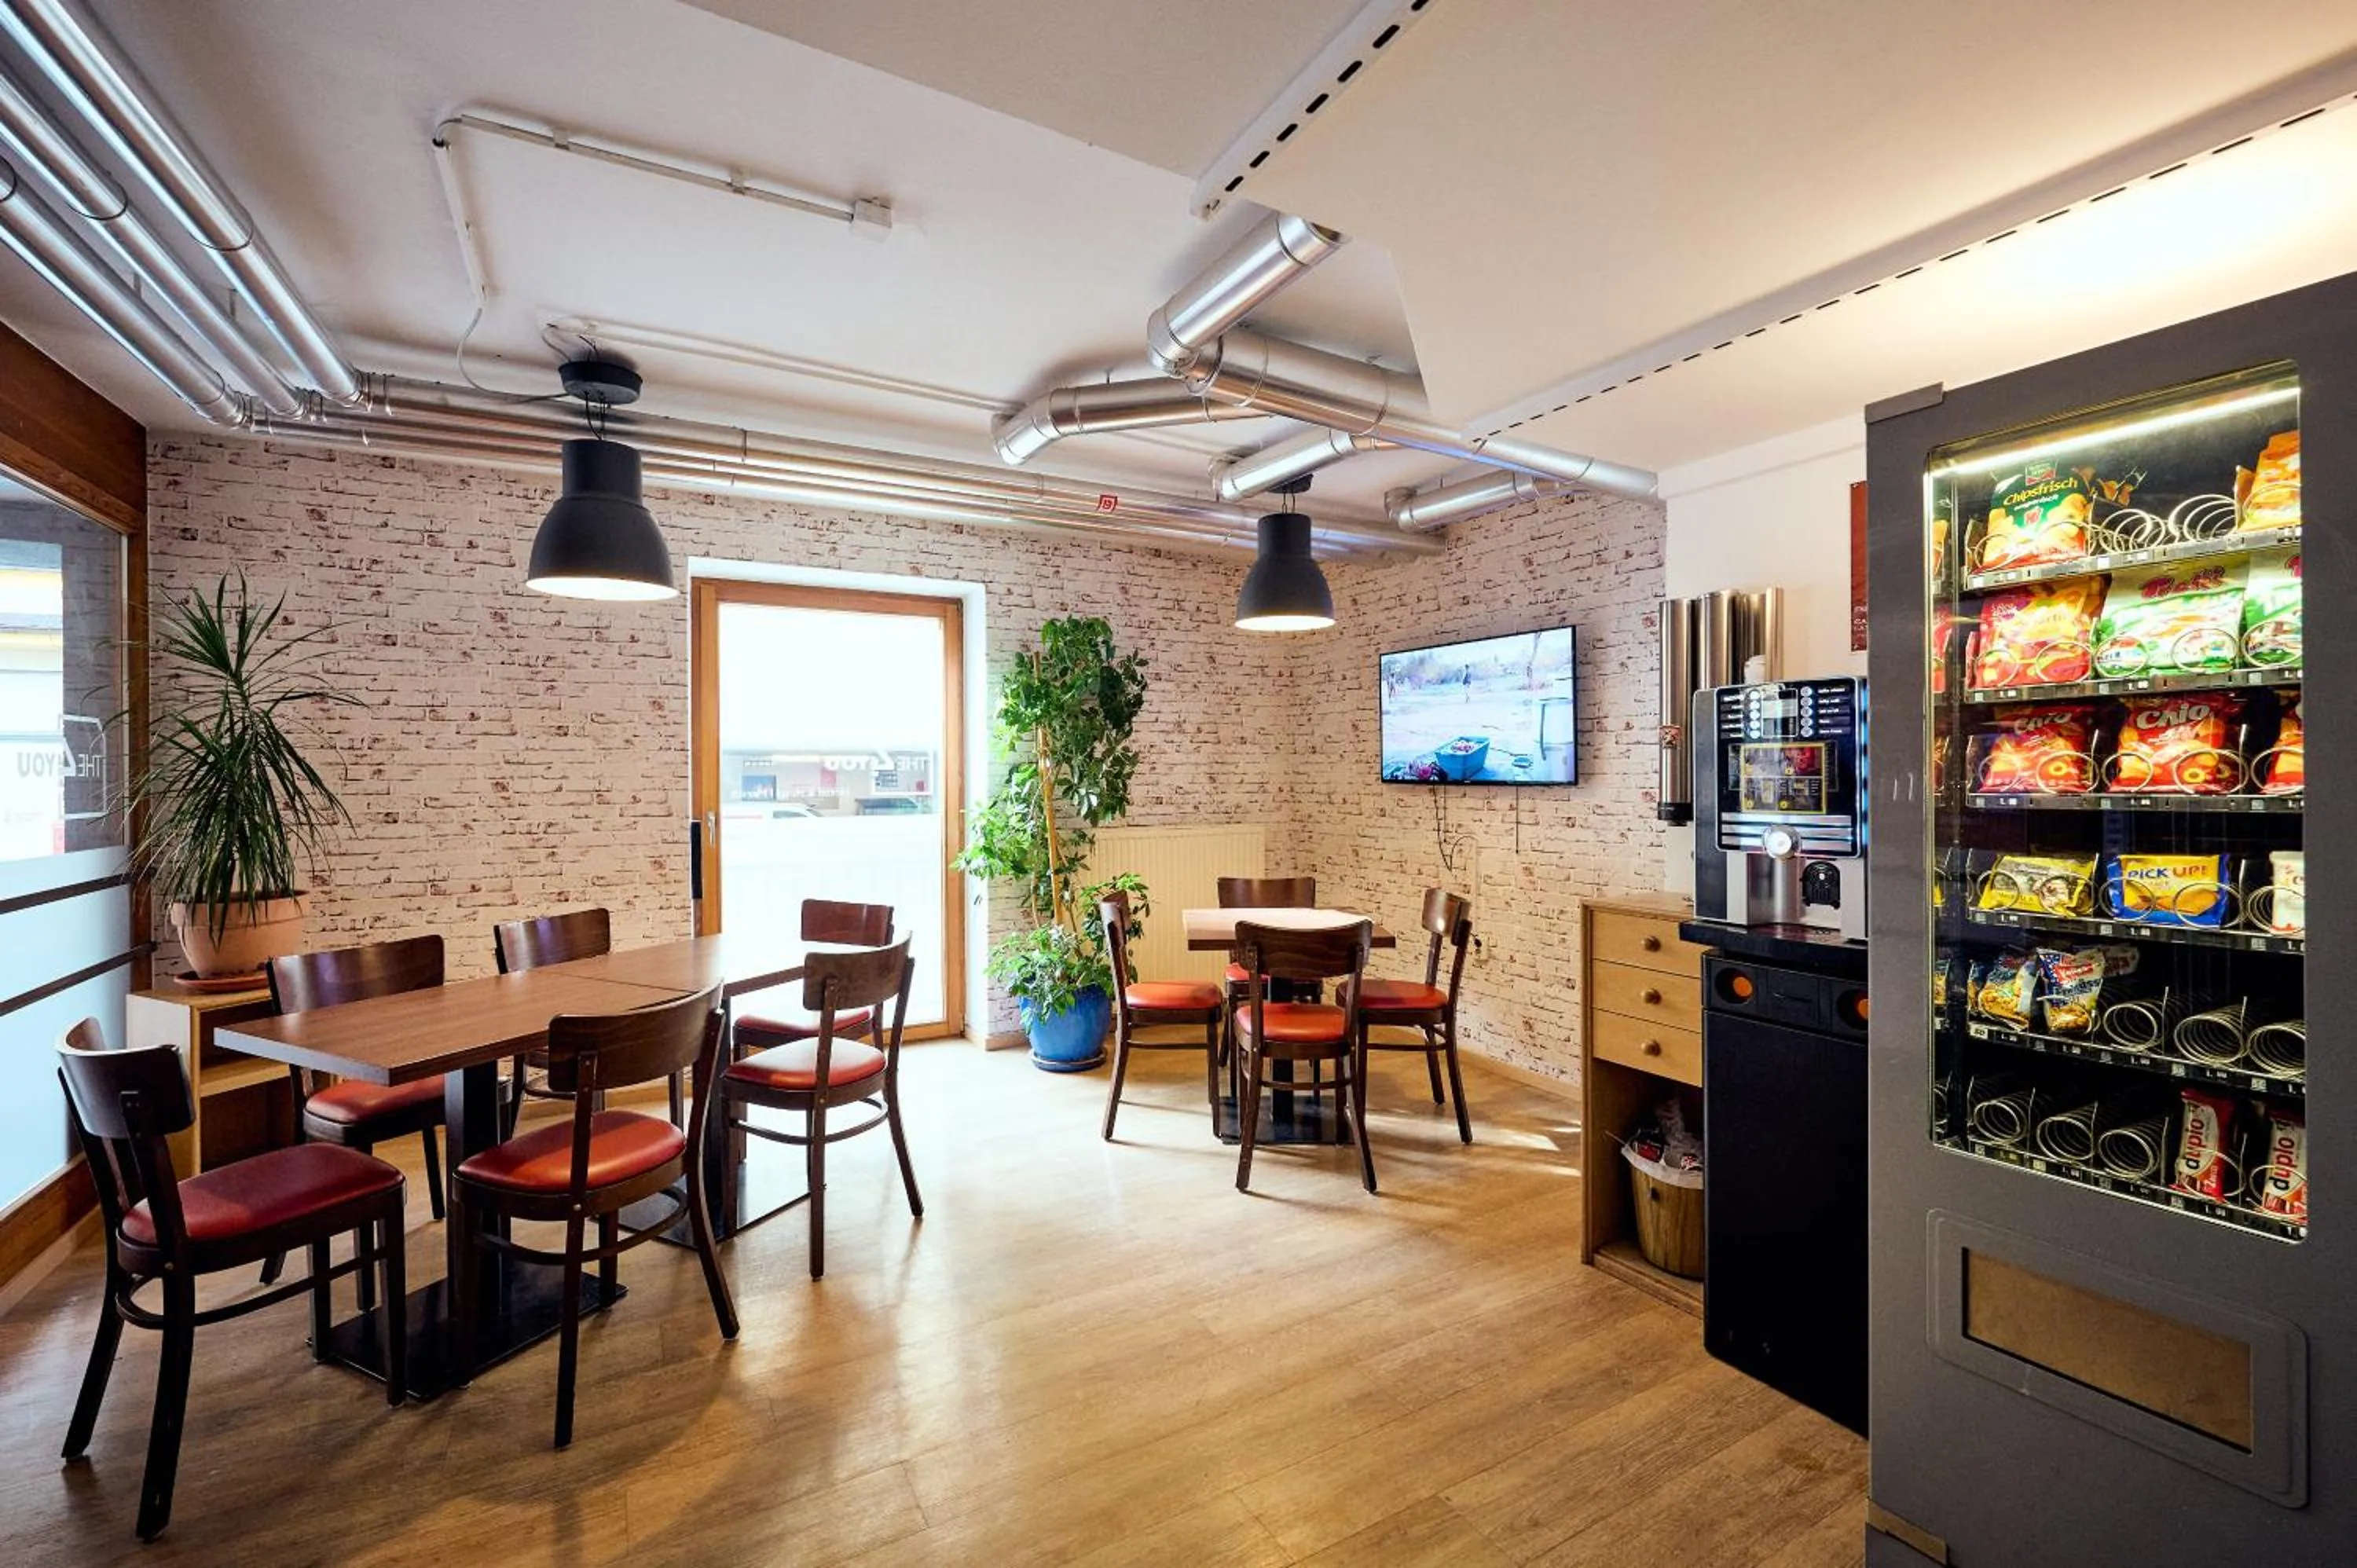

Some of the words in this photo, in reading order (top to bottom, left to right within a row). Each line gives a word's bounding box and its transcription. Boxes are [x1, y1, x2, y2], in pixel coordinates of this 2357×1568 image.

[2003, 477, 2078, 505] Chipsfrisch
[2136, 703, 2210, 730] Chio
[2184, 1118, 2206, 1170] duplo
[2269, 1137, 2297, 1190] duplo
